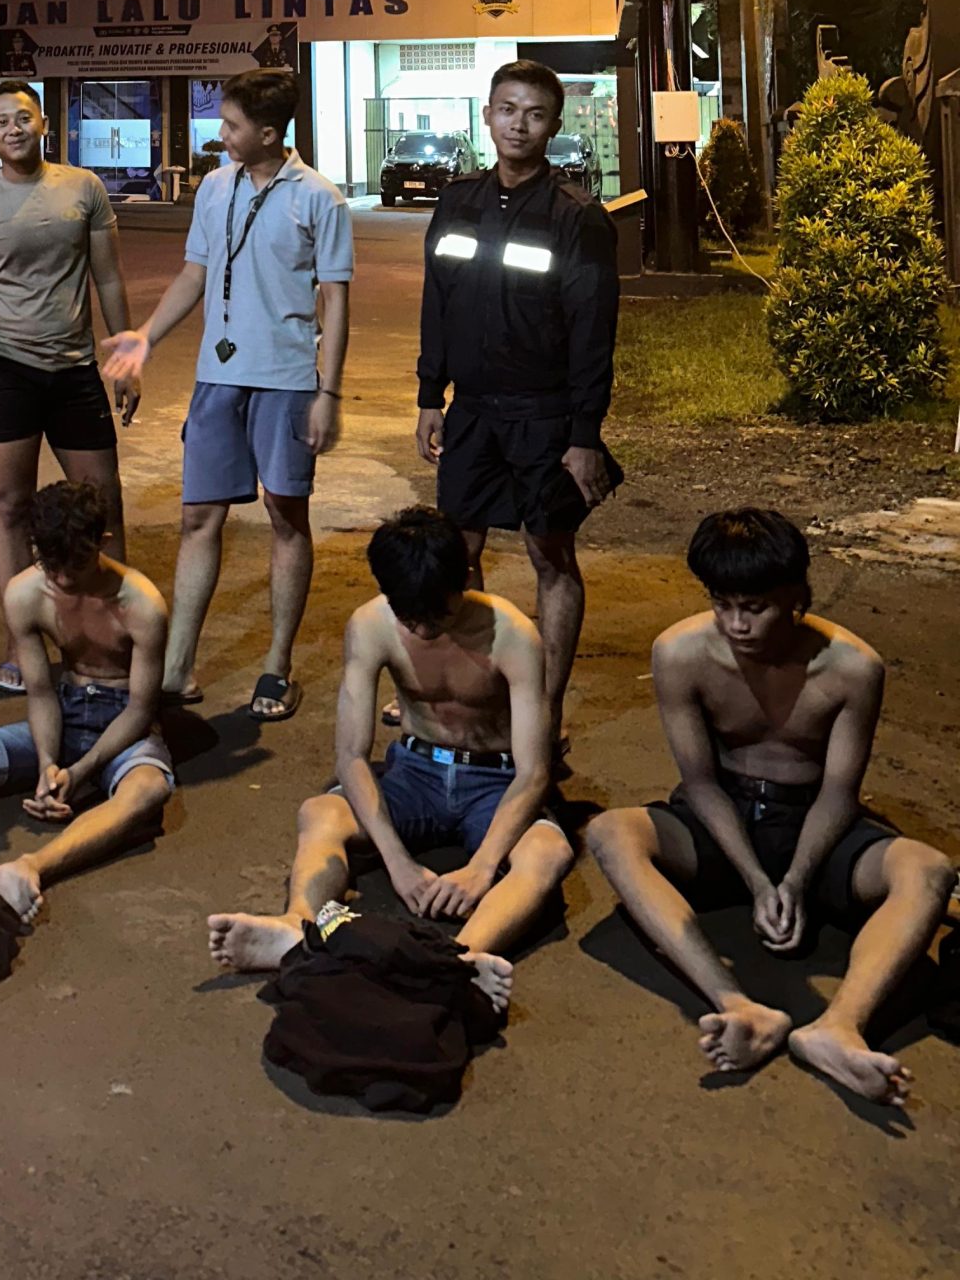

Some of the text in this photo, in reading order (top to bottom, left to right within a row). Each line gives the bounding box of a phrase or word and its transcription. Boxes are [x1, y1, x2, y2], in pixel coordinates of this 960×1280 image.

[36, 41, 254, 59] PROAKTIF, INOVATIF & PROFESIONAL
